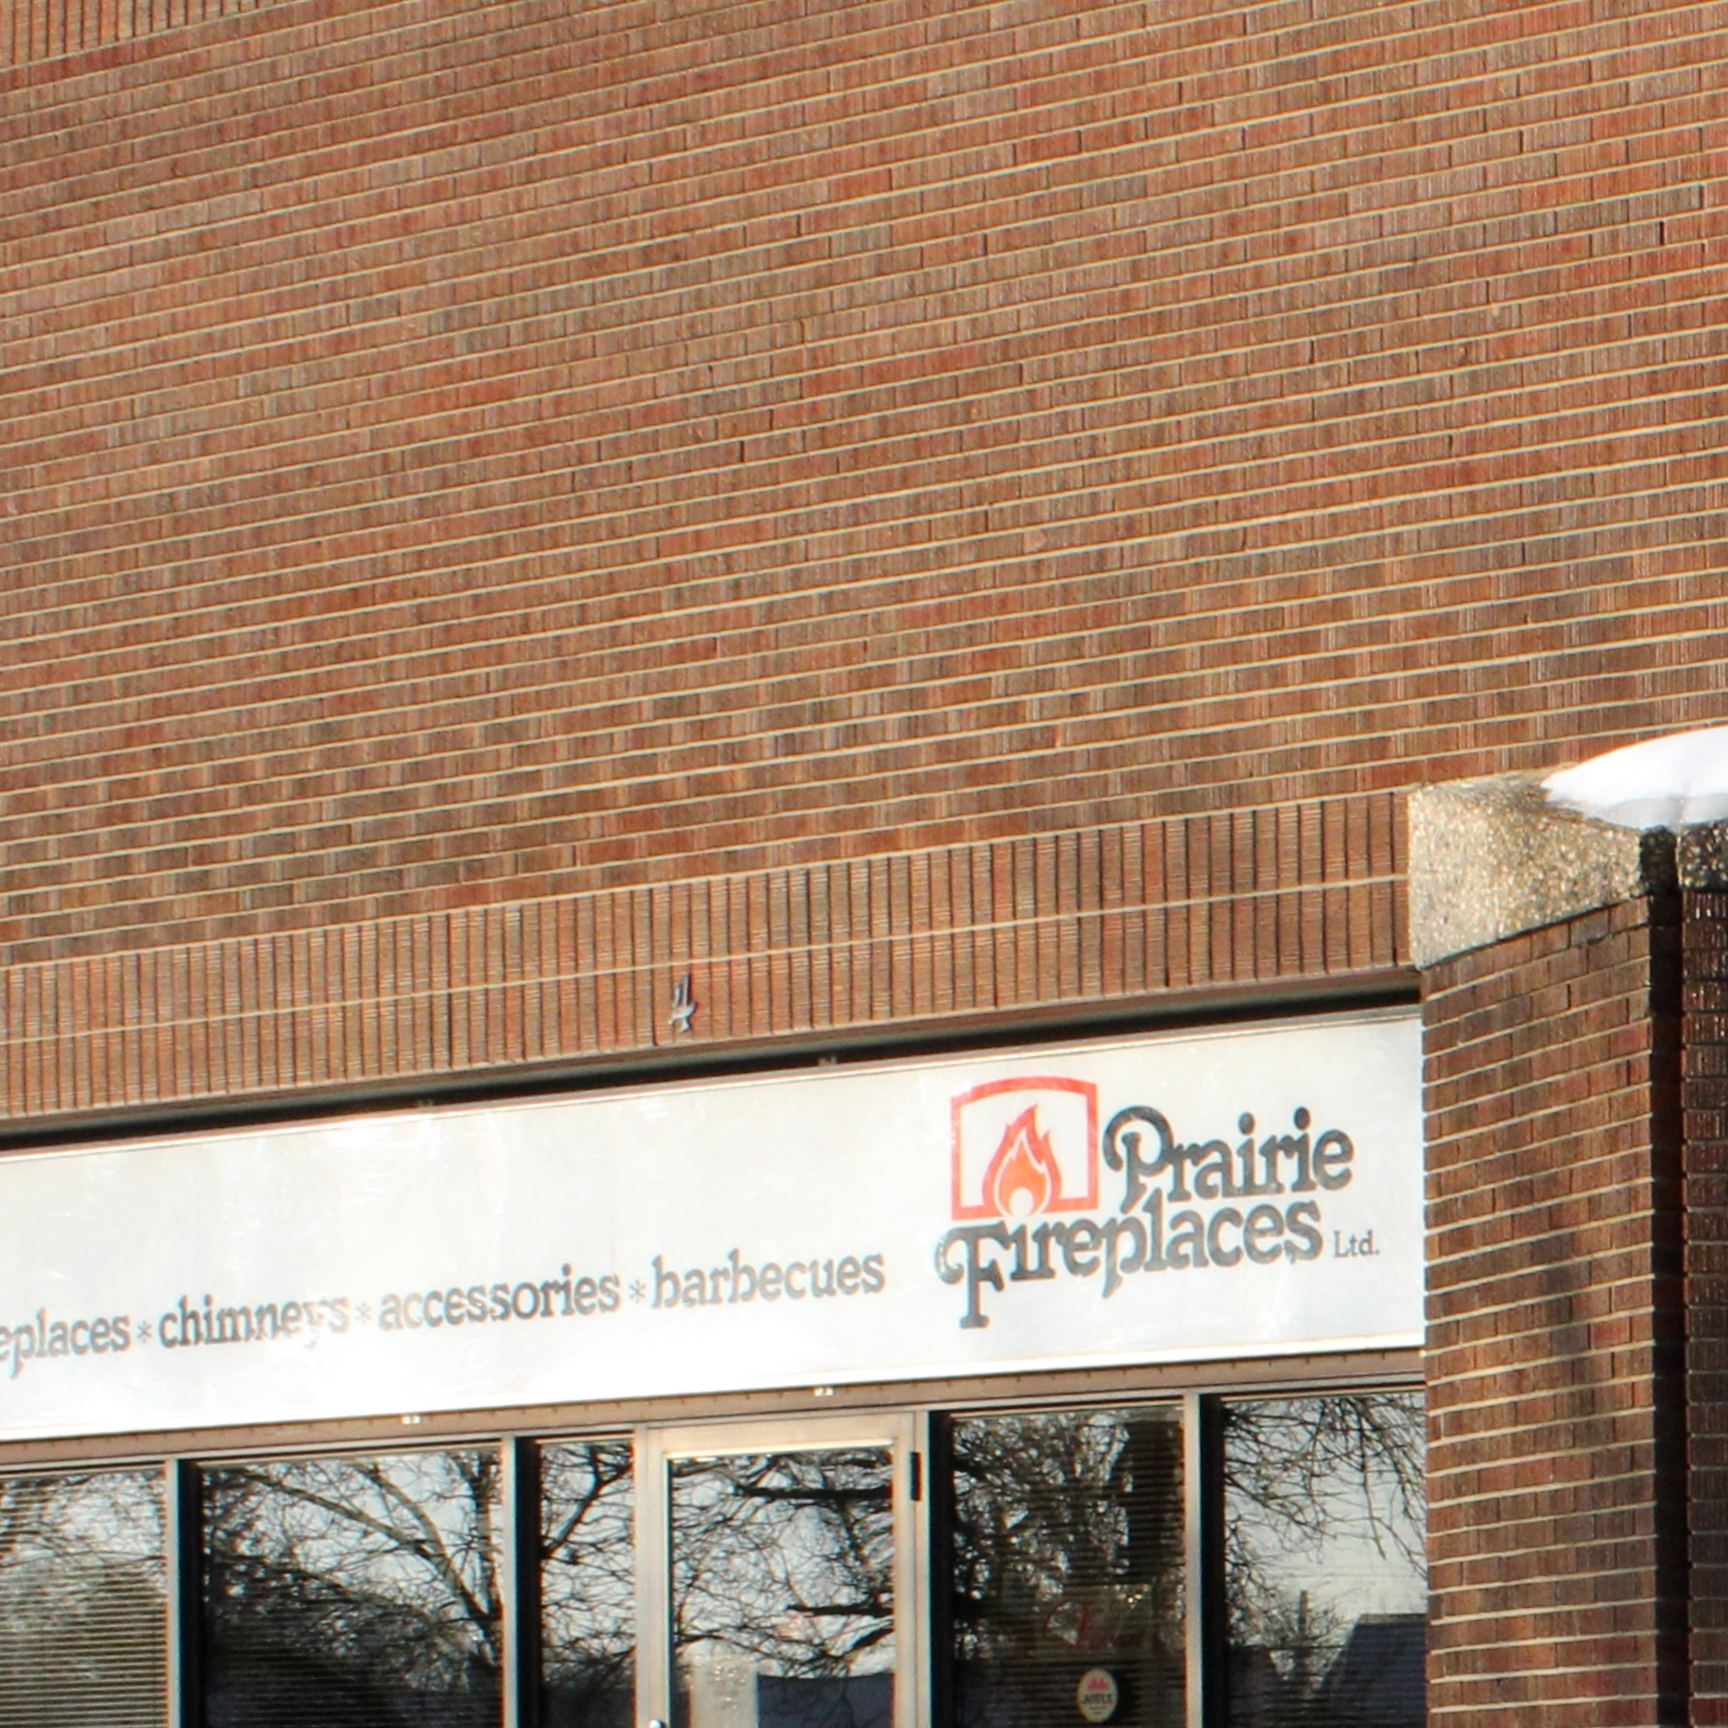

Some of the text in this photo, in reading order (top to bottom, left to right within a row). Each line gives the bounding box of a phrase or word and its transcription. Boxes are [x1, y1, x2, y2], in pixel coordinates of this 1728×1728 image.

[1102, 1105, 1355, 1214] Prairie
[159, 1294, 351, 1350] chimneys
[378, 1263, 621, 1331] accessories
[651, 1246, 886, 1310] barbecues
[934, 1188, 1381, 1329] Fireplaces Ltd.
